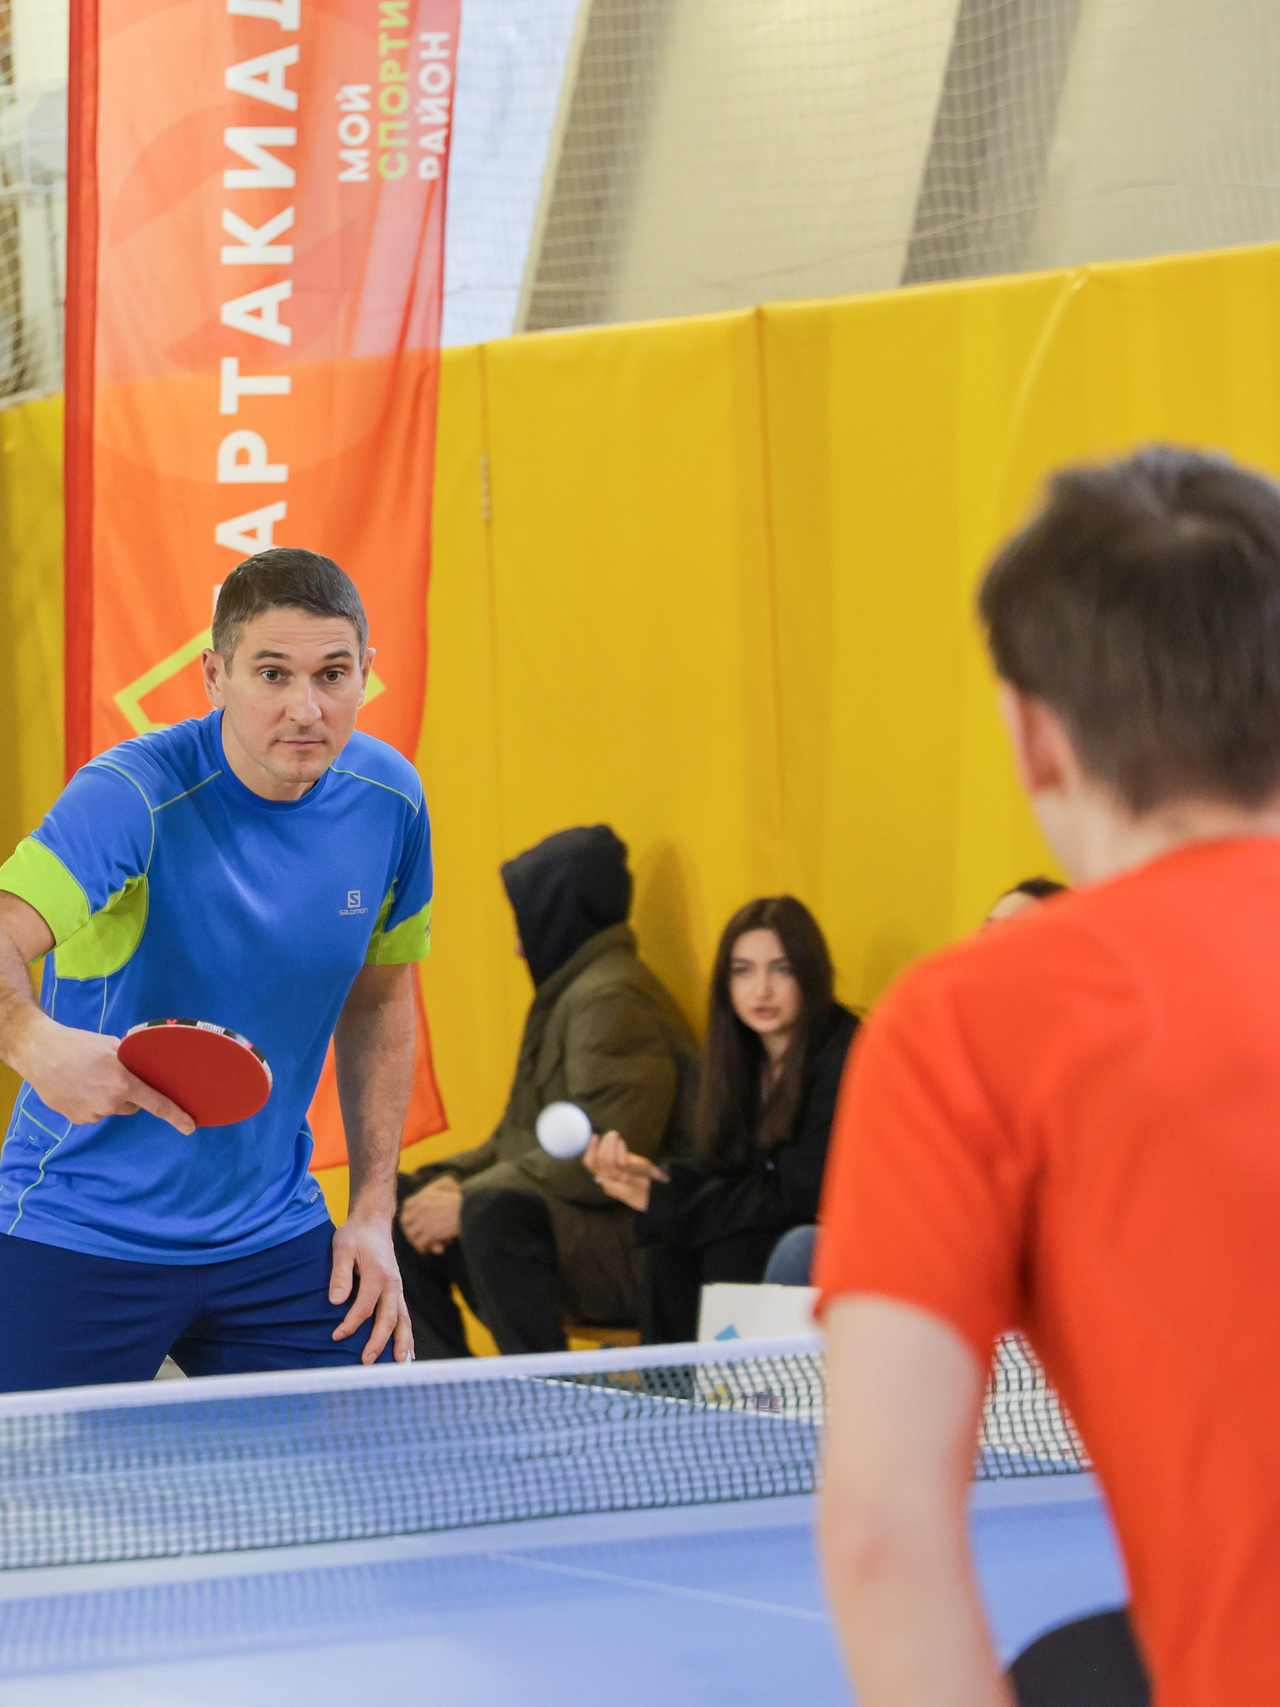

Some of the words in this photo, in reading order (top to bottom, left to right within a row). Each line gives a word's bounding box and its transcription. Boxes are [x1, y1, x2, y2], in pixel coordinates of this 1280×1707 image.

[336, 84, 372, 183] МОЙ
[377, 0, 411, 181] СПОРТИ
[416, 31, 452, 180] РАЙОН
